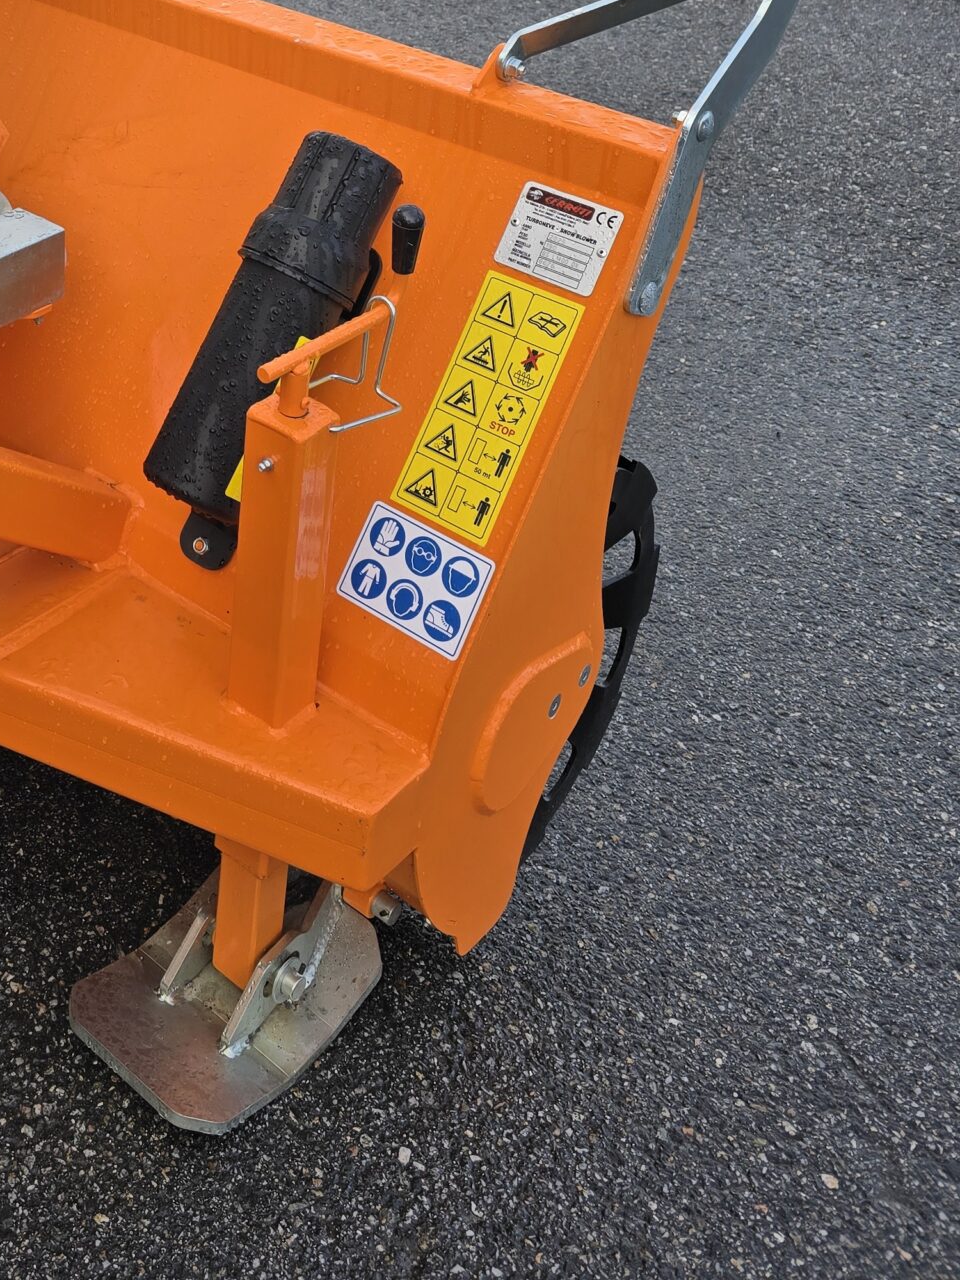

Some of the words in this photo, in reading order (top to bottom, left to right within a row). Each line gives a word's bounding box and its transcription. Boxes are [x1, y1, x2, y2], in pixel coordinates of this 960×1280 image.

[544, 196, 593, 217] CERRUTI
[596, 211, 618, 229] CE
[526, 215, 555, 231] TURBONEVE
[560, 227, 576, 238] SNOW
[575, 232, 597, 245] BLOWER
[489, 421, 515, 437] STOP
[473, 467, 482, 475] 50
